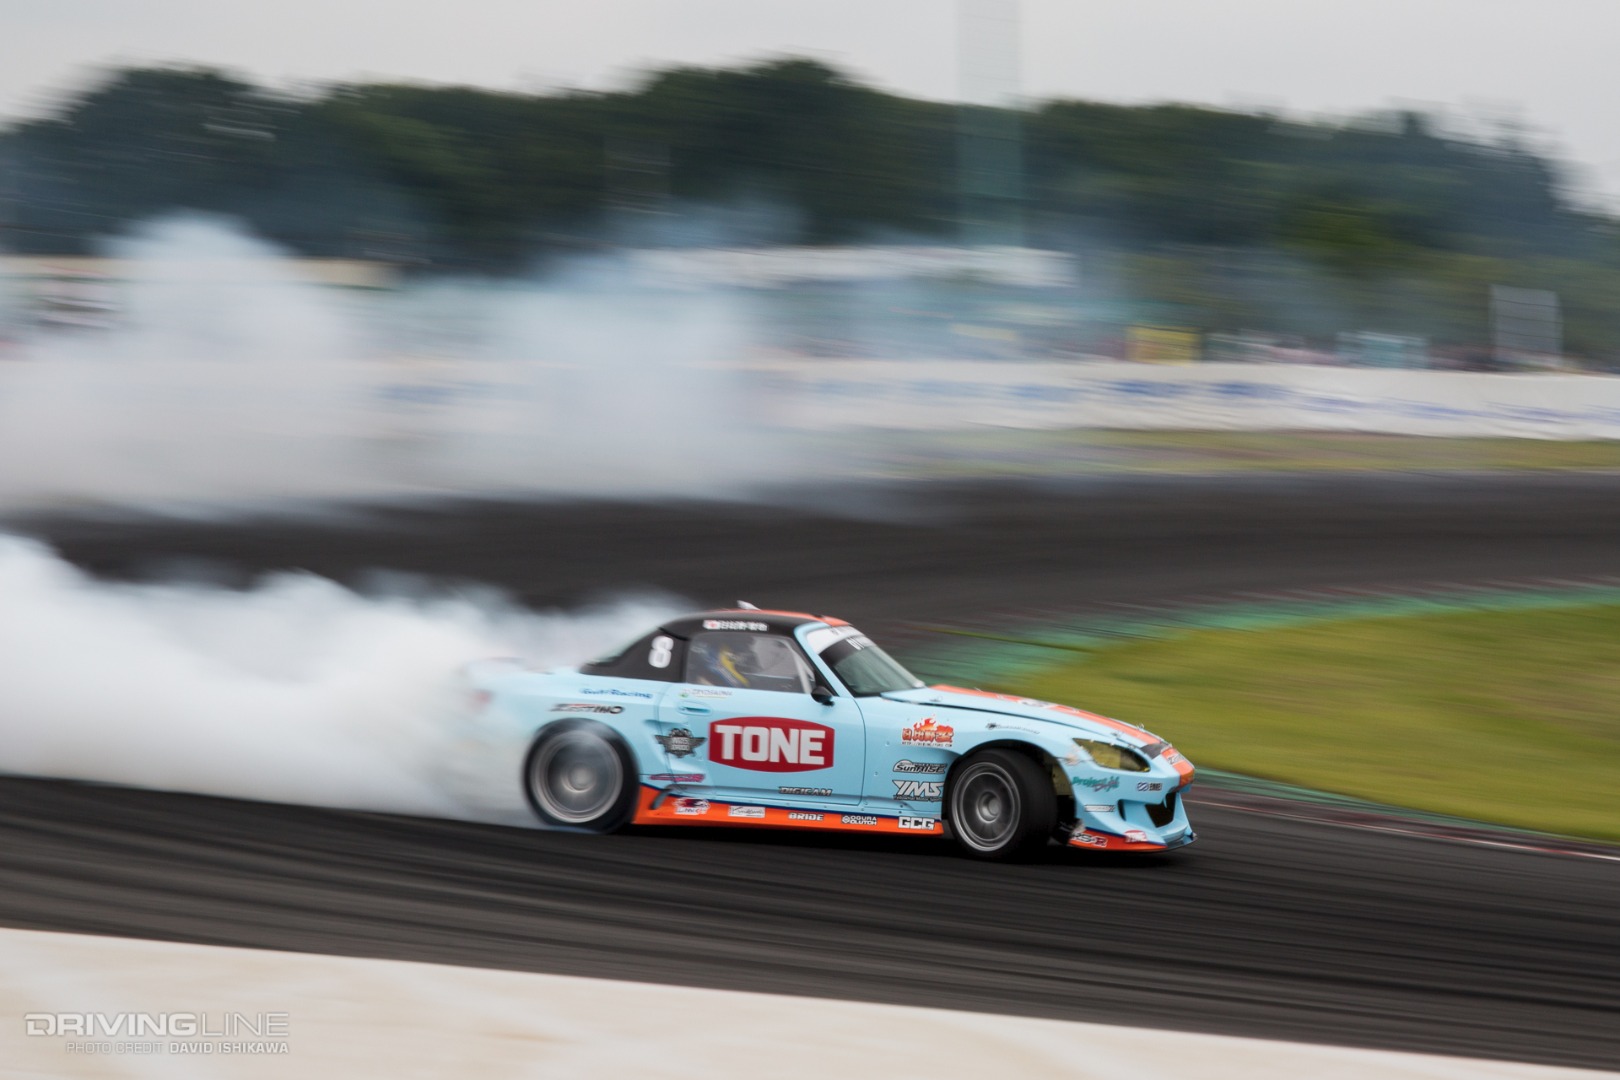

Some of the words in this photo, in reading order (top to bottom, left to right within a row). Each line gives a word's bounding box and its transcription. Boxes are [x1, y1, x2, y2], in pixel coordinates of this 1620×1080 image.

[648, 635, 674, 668] 8
[714, 724, 827, 766] TONE
[788, 812, 825, 821] BRIDE
[898, 817, 935, 831] GCG
